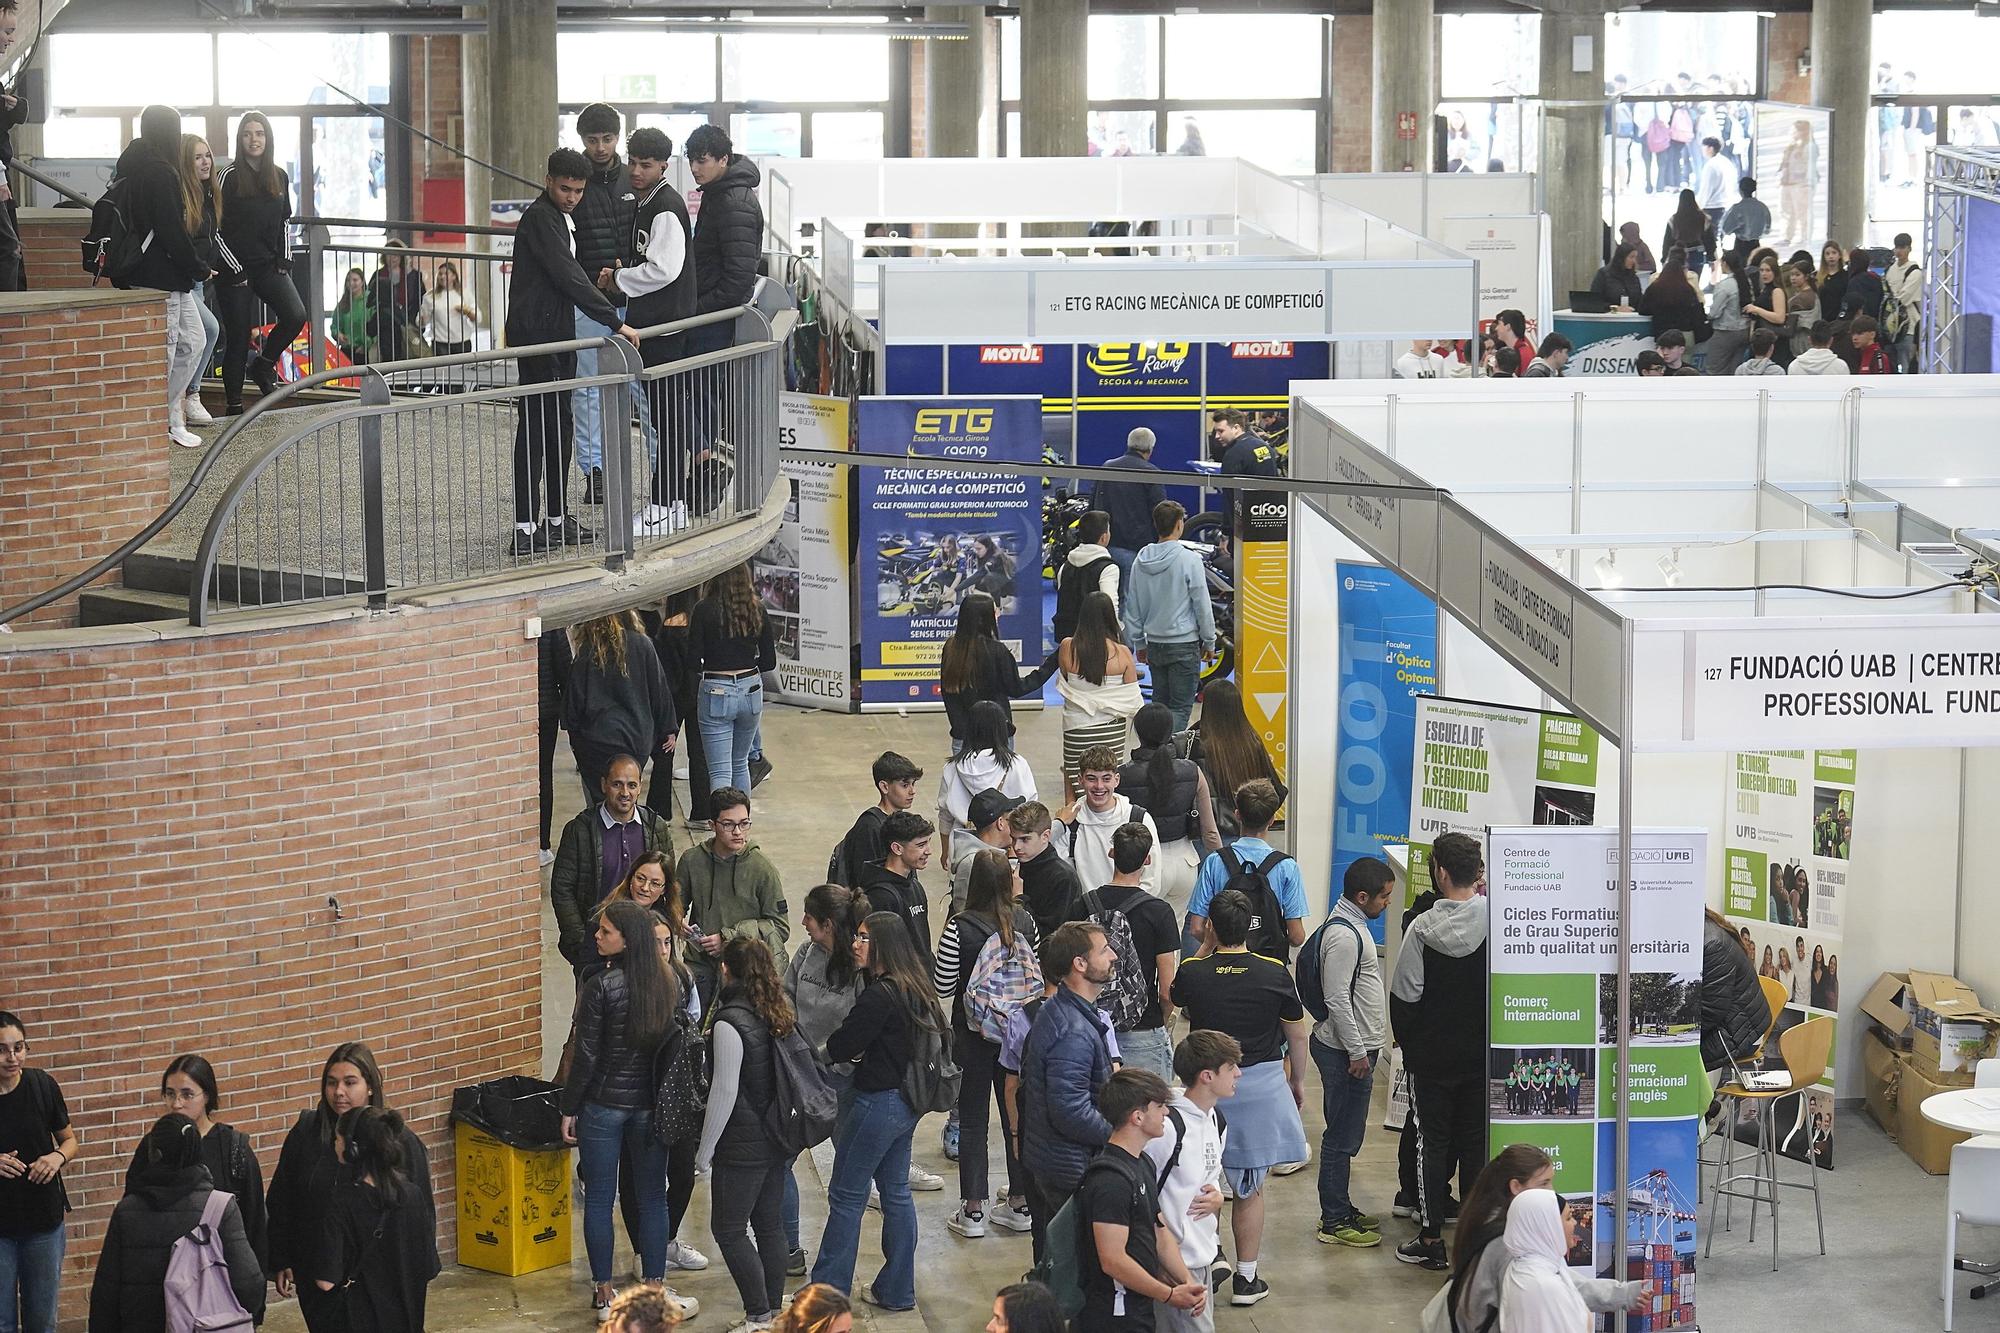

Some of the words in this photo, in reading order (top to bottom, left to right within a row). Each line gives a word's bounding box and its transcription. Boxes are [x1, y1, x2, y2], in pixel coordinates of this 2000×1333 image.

[1065, 297, 1091, 311] ETG
[1096, 296, 1146, 311] RACING
[1151, 292, 1219, 310] MECÀNICA
[1225, 295, 1240, 309] DE
[1245, 290, 1324, 309] COMPETICIÓ
[982, 346, 1041, 362] MOTUL
[1234, 342, 1292, 357] MOTUL
[1143, 355, 1185, 374] Racing
[1099, 378, 1132, 386] ESCOLA
[914, 408, 994, 434] ETG
[965, 434, 989, 442] Girona
[943, 445, 988, 458] racing
[883, 468, 924, 481] TÈCNIC
[876, 482, 936, 495] MECÀNICA
[938, 484, 953, 495] de
[954, 481, 1026, 495] COMPETICIÓ
[872, 502, 892, 510] CICLE
[892, 501, 928, 510] FORMATIU
[929, 501, 950, 509] GRAU
[950, 501, 985, 509] SUPERIOR
[985, 500, 1029, 509] AUTOMOCIÓ
[910, 617, 959, 629] MATRÍCULA
[910, 630, 934, 638] SENSE
[1386, 641, 1411, 649] Facultat
[779, 663, 832, 679] MANTENIMENT
[833, 671, 843, 680] DE
[1704, 669, 1722, 680] 127
[1730, 649, 1844, 680] FUNDACIÓ
[1851, 654, 1896, 678] UAB
[1396, 669, 1436, 685] Optom
[780, 674, 843, 698] VEHICLES
[1764, 691, 1933, 716] PROFESSIONAL
[1425, 720, 1471, 747] ESCUELA
[1472, 727, 1484, 748] DE
[1545, 719, 1582, 736] PRÁCTICAS
[1337, 623, 1388, 855] FOOT
[1424, 742, 1488, 770] PREVENCIÓN
[1745, 754, 1770, 774] TURISME
[1423, 765, 1431, 785] Y
[1432, 766, 1489, 793] SEGURIDAD
[1767, 776, 1797, 797] HOTELERA
[1421, 787, 1469, 813] INTEGRAL
[1504, 848, 1536, 857] Centre
[1537, 848, 1550, 857] de
[1504, 859, 1550, 869] Formació
[1504, 871, 1564, 880] Professional
[1503, 907, 1547, 921] Cicles
[1504, 924, 1521, 938] de
[1526, 924, 1559, 938] Grau
[1564, 924, 1619, 939] Superio
[1503, 941, 1535, 954] amb
[1540, 941, 1595, 957] qualitat
[1600, 940, 1690, 954] unersitària
[1504, 995, 1549, 1010] Comerç
[1504, 1009, 1580, 1022] Internacional
[1612, 1062, 1657, 1077] Cmerç
[1630, 1088, 1668, 1104] anglès
